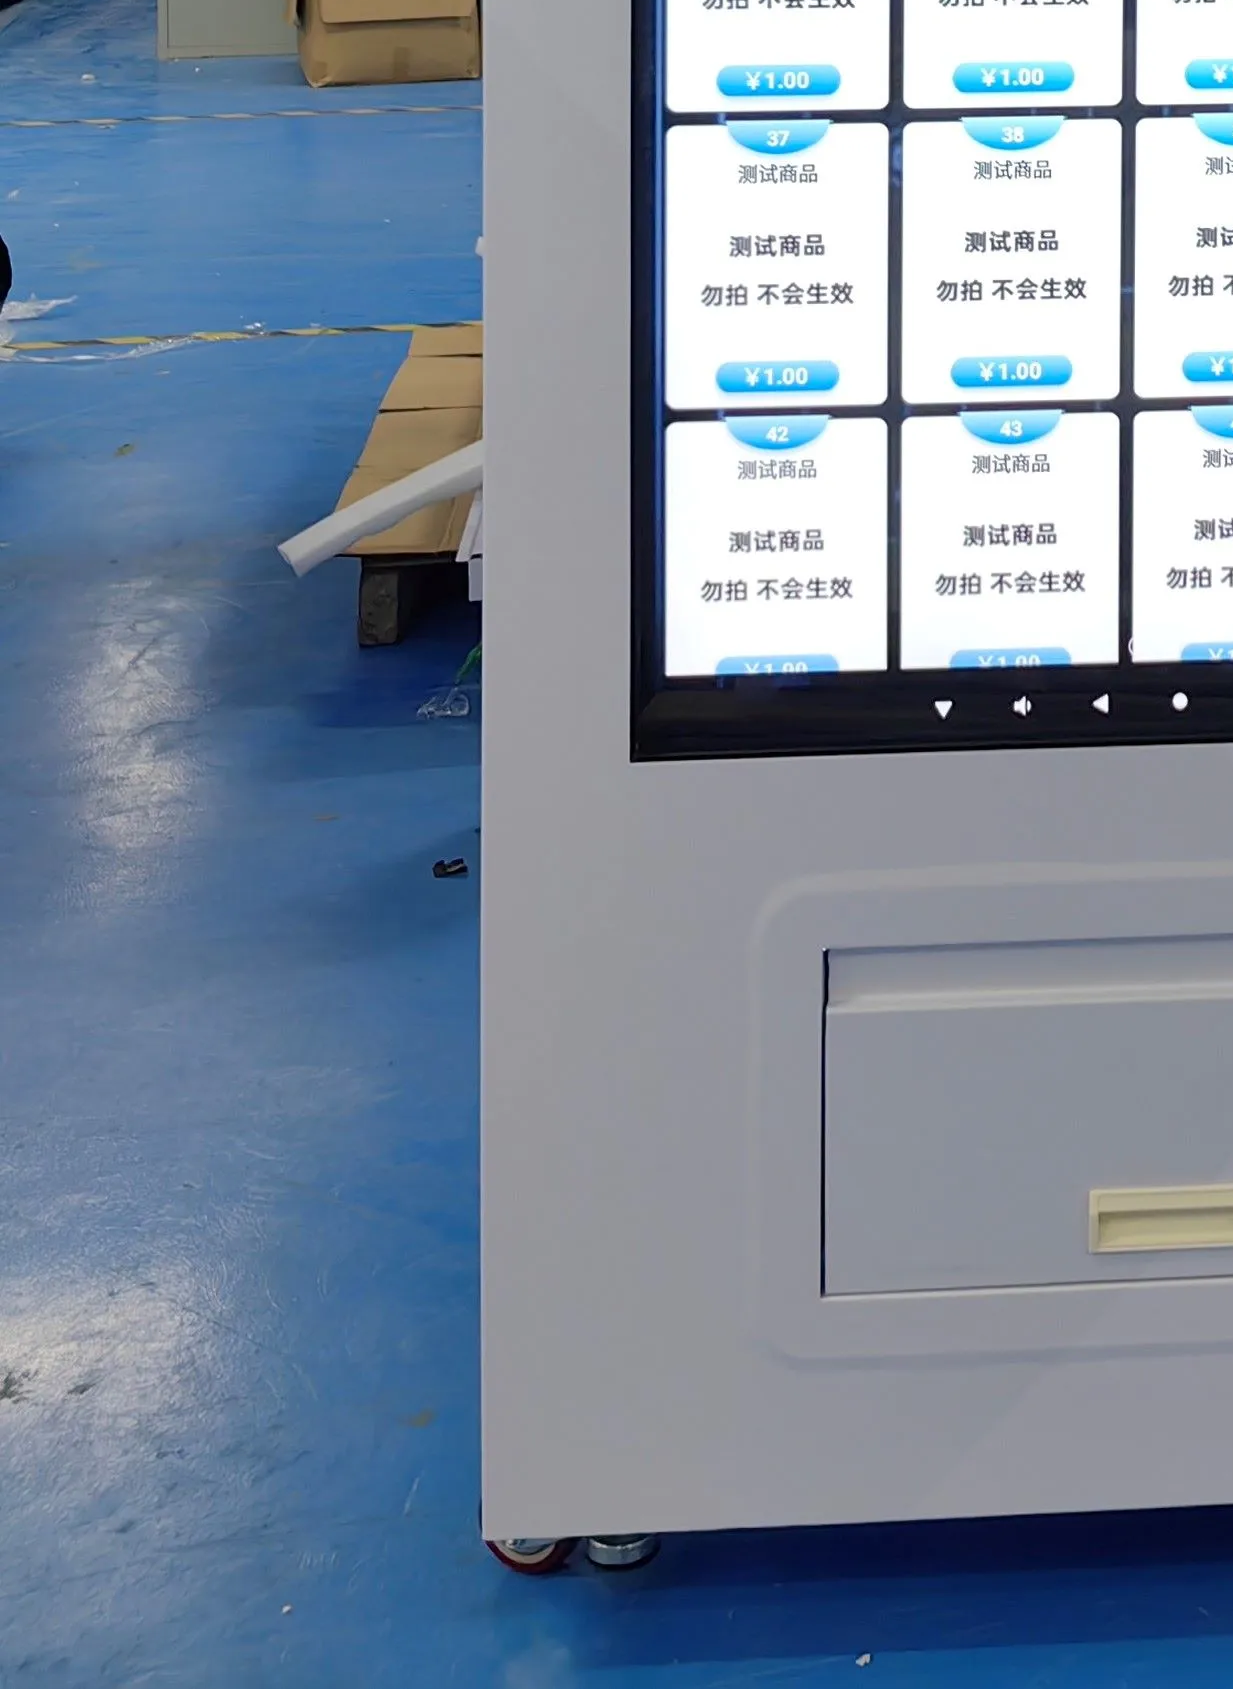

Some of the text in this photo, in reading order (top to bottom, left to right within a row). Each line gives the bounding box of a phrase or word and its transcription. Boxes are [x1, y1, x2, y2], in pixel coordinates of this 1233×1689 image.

[766, 130, 789, 148] 37
[1001, 127, 1023, 143] 38
[738, 163, 818, 184] 测试商品
[973, 159, 1052, 180] 测试商品
[730, 235, 824, 257] 测试商品
[965, 230, 1058, 252] 测试商品
[702, 283, 853, 306] 勿拍 不会生效
[937, 278, 1086, 301] 勿拍 不会生效
[1169, 275, 1213, 296] 勿拍
[766, 426, 789, 442] 42
[999, 421, 1023, 437] 43
[737, 459, 817, 480] 测试商品
[971, 453, 1051, 474] 测试商品
[730, 530, 823, 552] 测试商品
[964, 524, 1056, 546] 测试商品
[936, 571, 1084, 595] 勿拍 不会生效
[1167, 567, 1211, 588] 勿拍
[702, 577, 852, 601] 勿拍 不会生效
